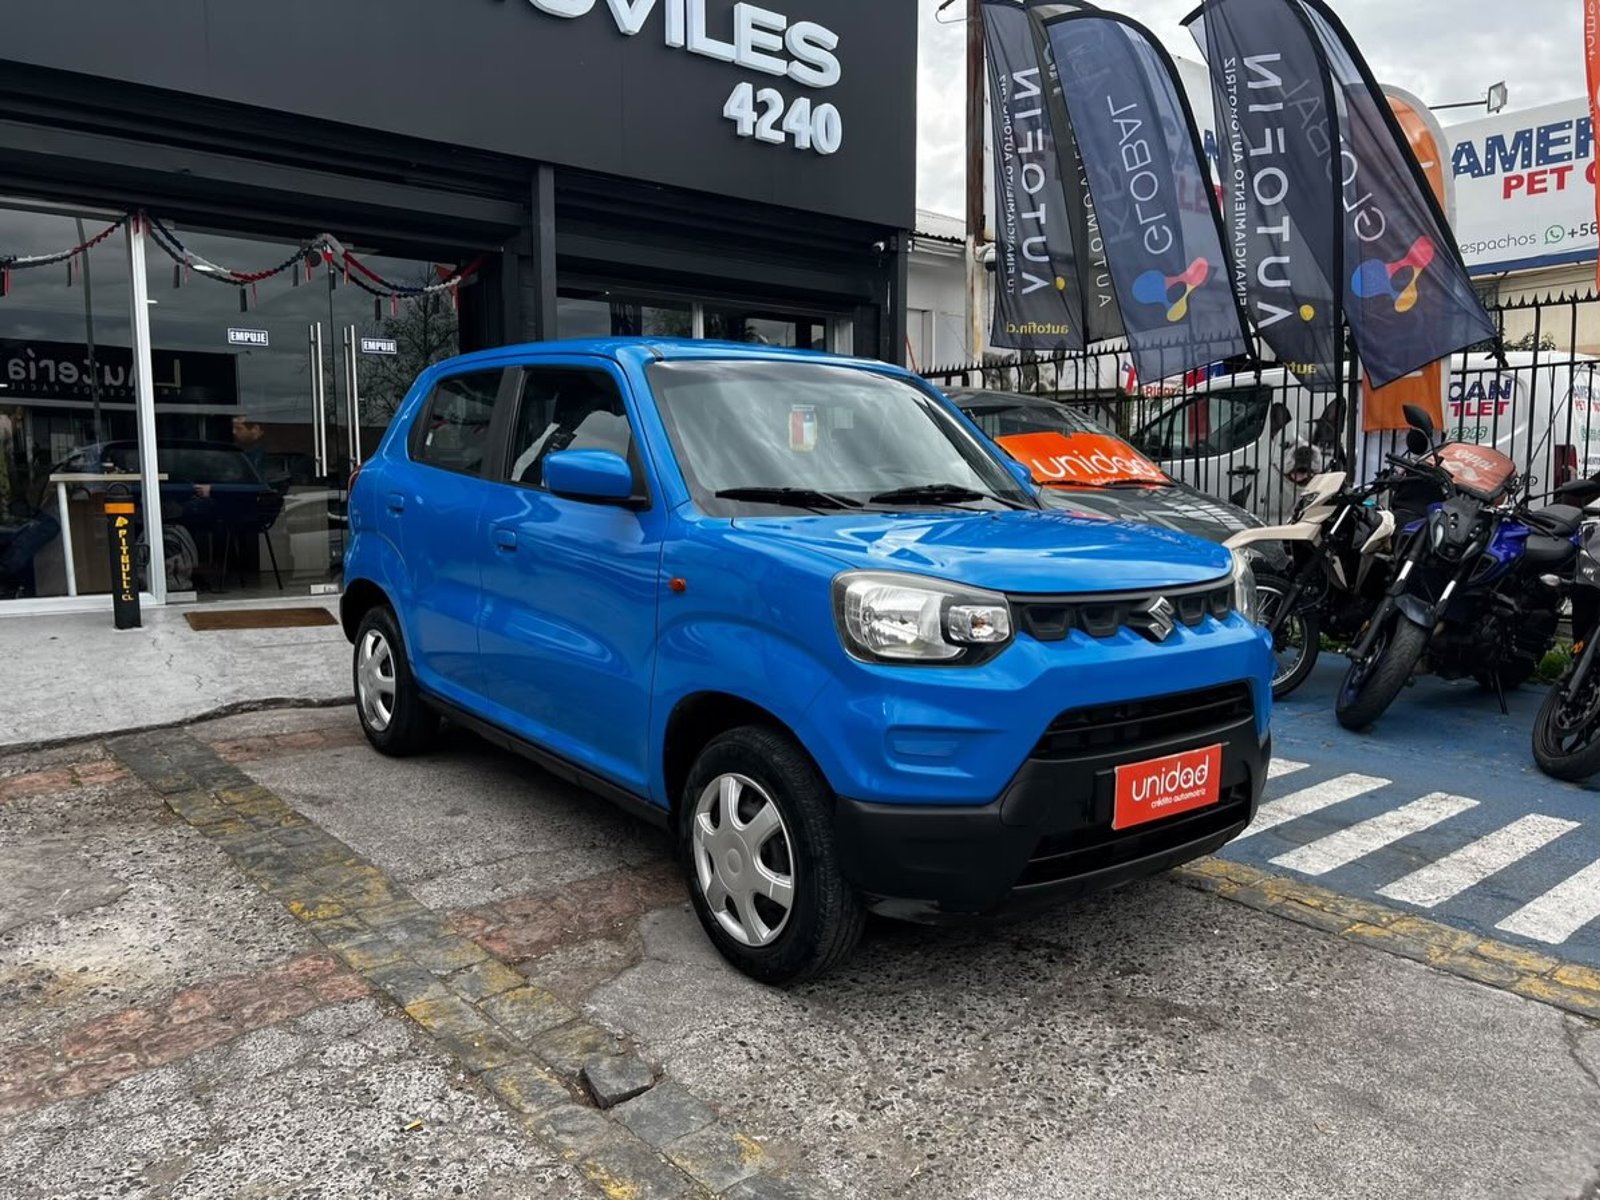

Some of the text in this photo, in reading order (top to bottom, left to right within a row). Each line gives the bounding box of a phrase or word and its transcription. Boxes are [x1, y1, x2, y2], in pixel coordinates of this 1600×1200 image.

[529, 0, 842, 88] VILES
[723, 82, 842, 155] 4240
[1503, 165, 1573, 200] PET
[1459, 233, 1537, 255] espachos
[230, 331, 267, 343] EMPUJE
[363, 341, 395, 352] EMPUJE
[1031, 448, 1157, 478] unidad
[1132, 754, 1209, 802] unidad
[1173, 788, 1207, 803] automotriz
